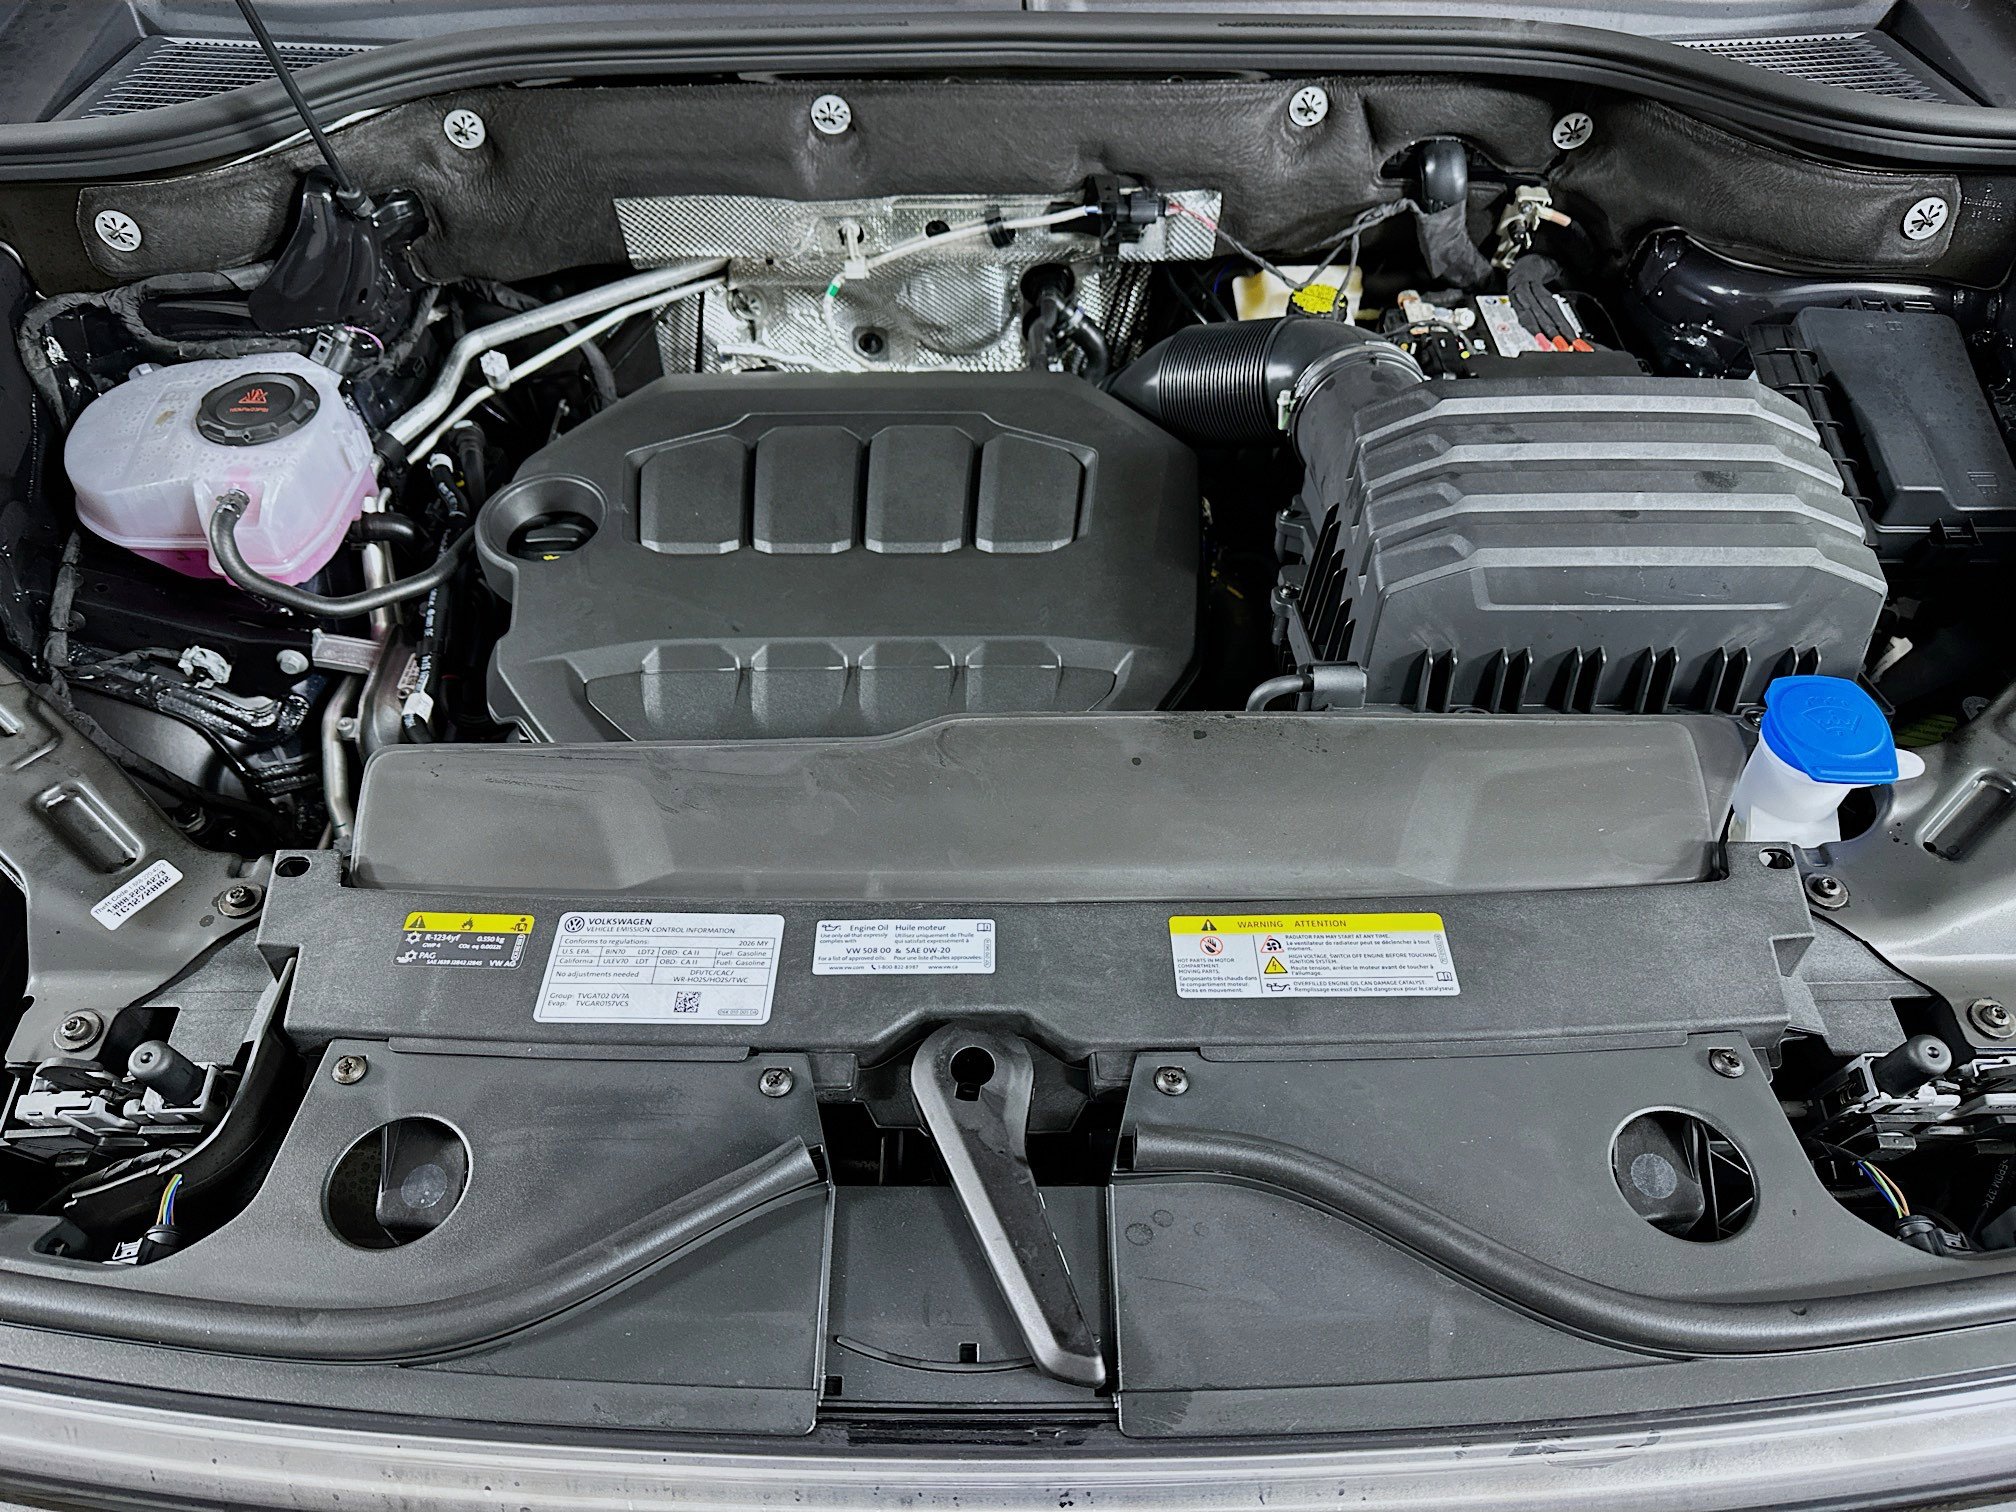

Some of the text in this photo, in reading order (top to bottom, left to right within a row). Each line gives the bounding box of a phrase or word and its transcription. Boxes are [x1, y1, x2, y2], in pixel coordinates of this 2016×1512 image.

[111, 889, 128, 901] Code
[425, 934, 461, 943] R-1234yf
[496, 936, 505, 944] kg
